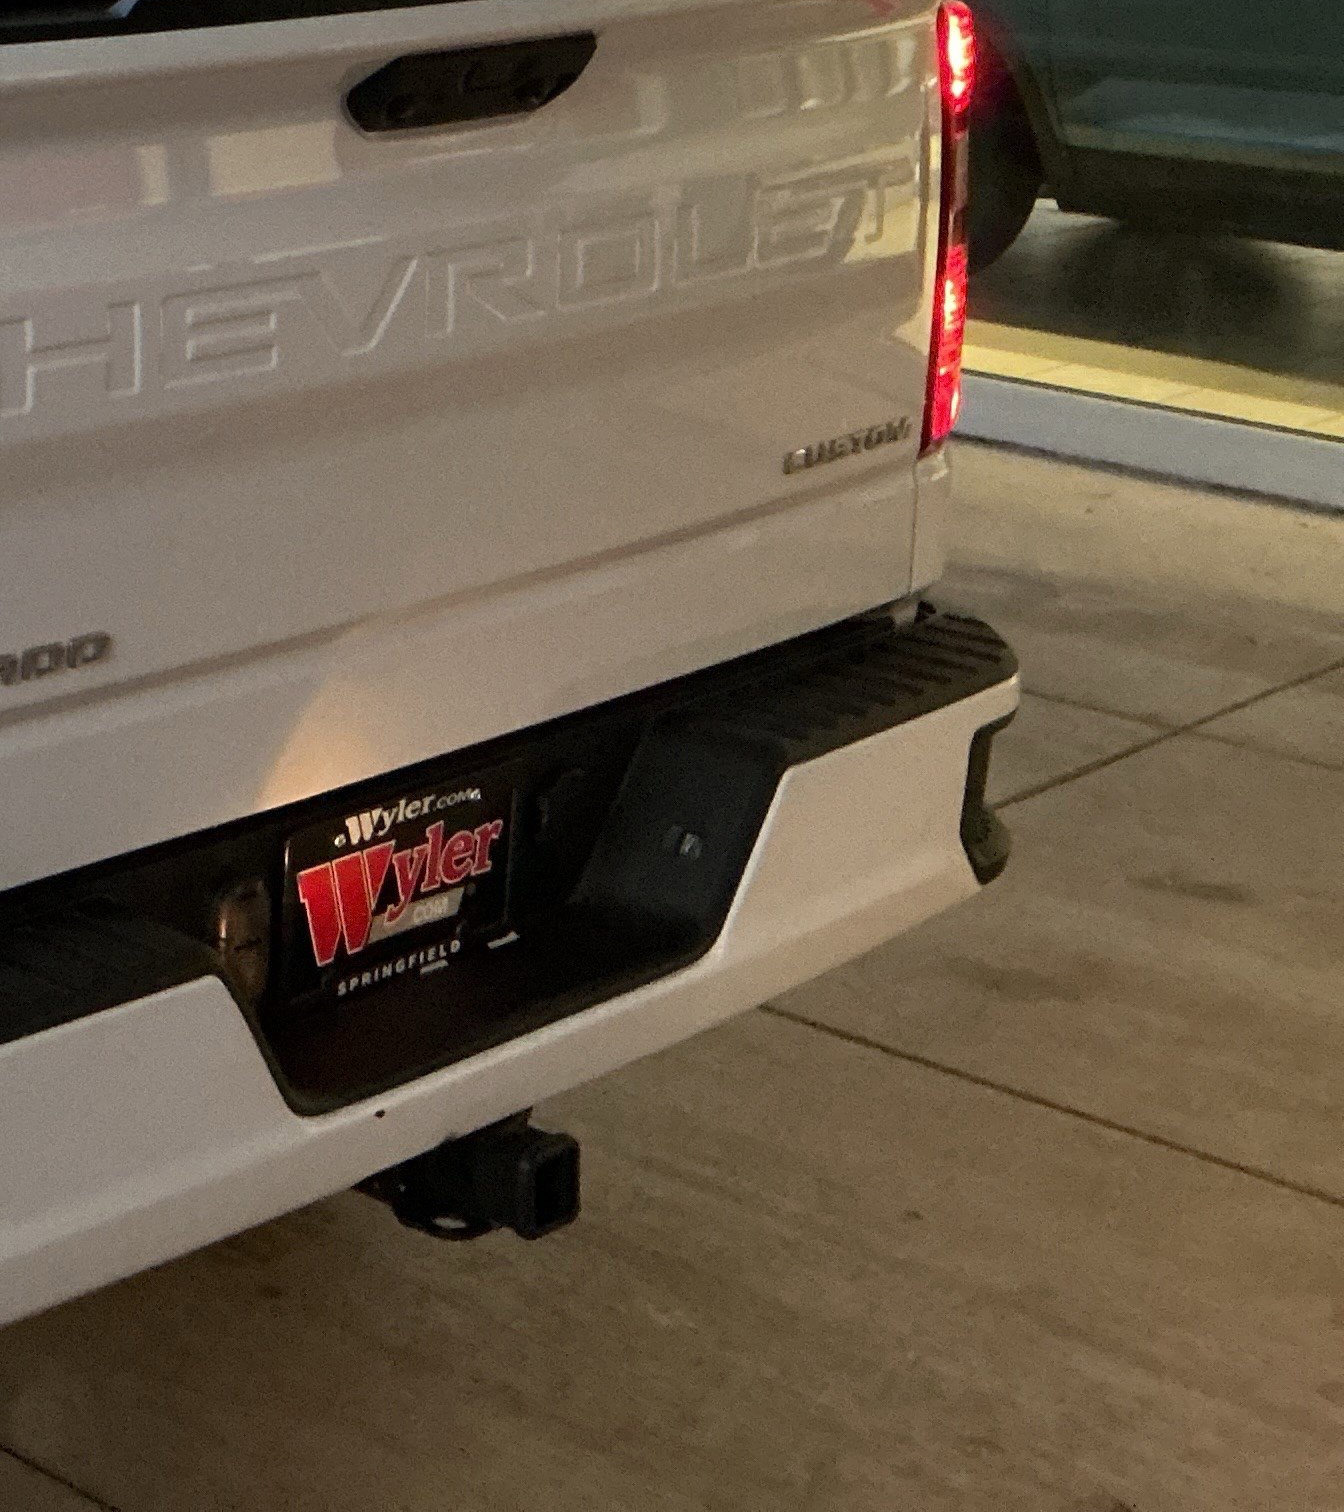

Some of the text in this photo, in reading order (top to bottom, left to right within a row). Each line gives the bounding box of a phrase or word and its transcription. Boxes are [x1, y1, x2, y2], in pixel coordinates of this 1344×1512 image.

[782, 416, 912, 475] CUSTOM
[297, 819, 504, 967] Wyler
[337, 939, 461, 996] SPRINGFIELD
